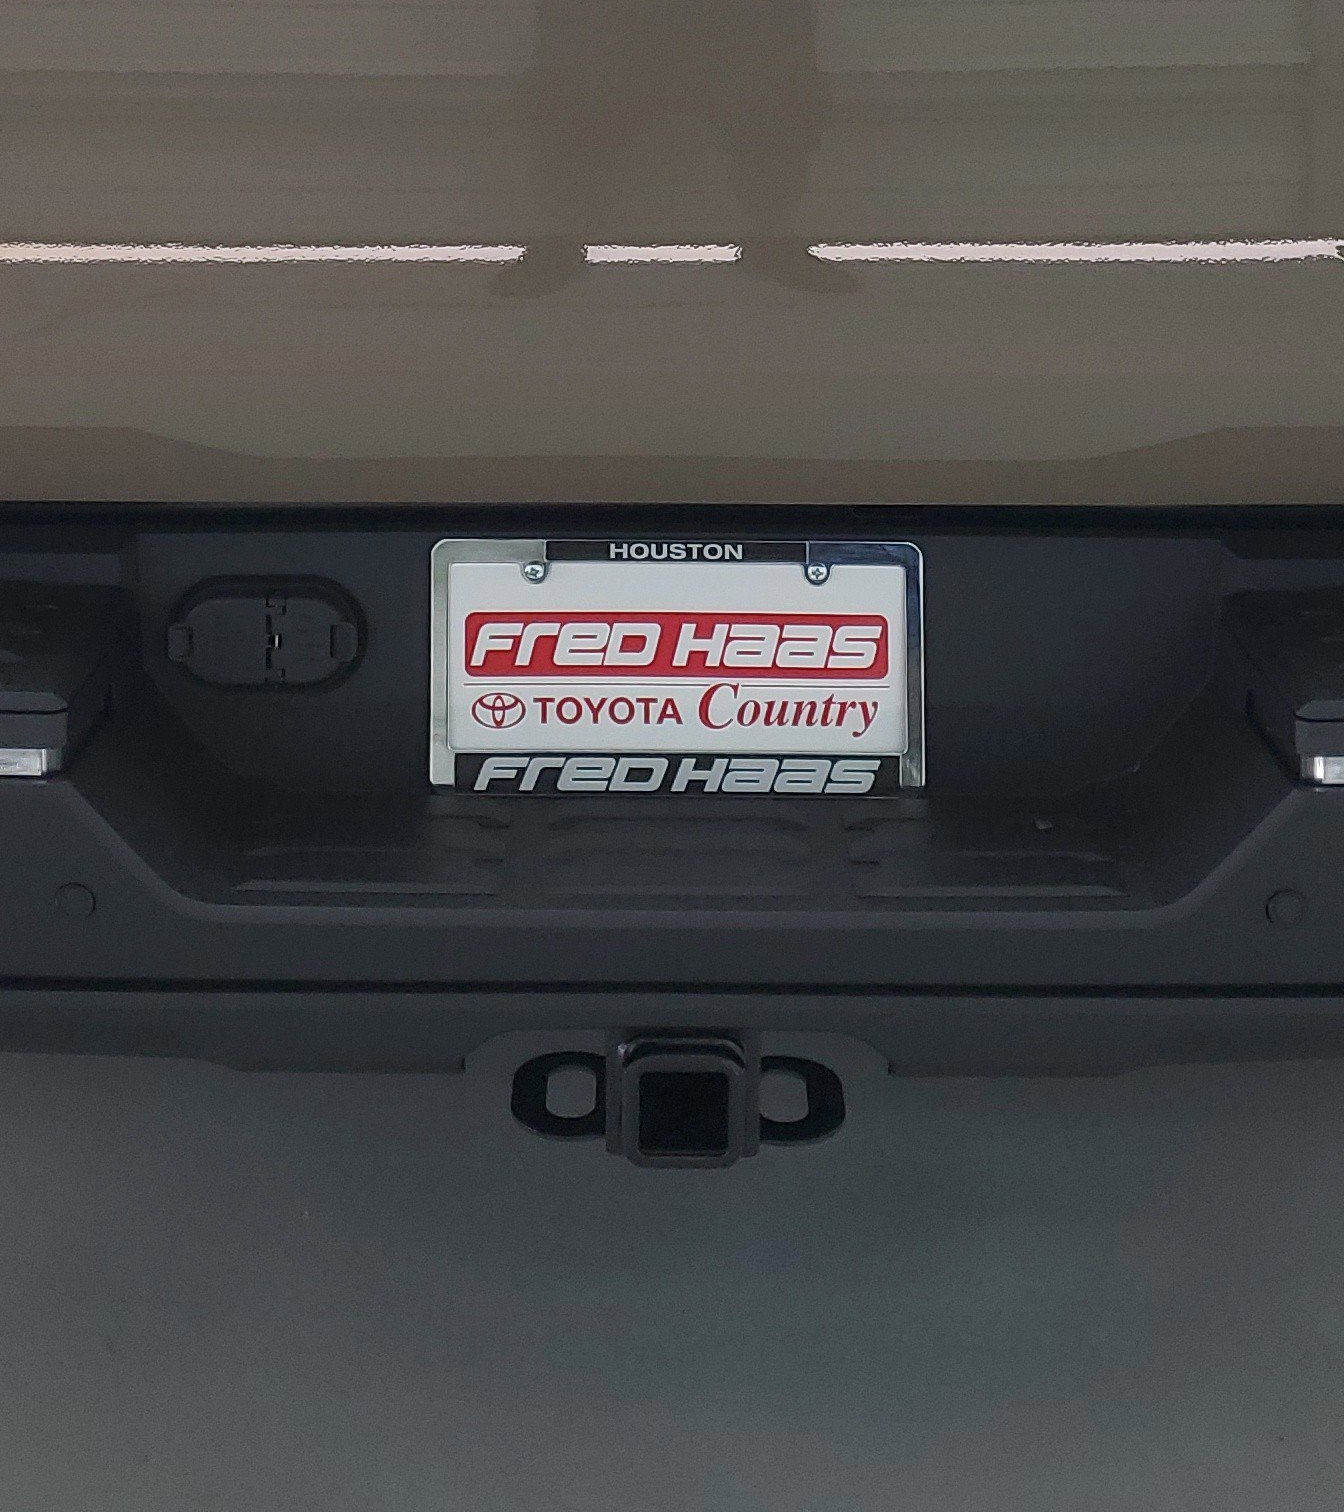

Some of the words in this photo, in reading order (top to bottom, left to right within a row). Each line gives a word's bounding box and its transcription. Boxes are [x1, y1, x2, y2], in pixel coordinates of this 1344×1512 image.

[608, 542, 744, 561] HOUSTON
[532, 695, 684, 726] TOYOTA
[697, 681, 879, 738] Country
